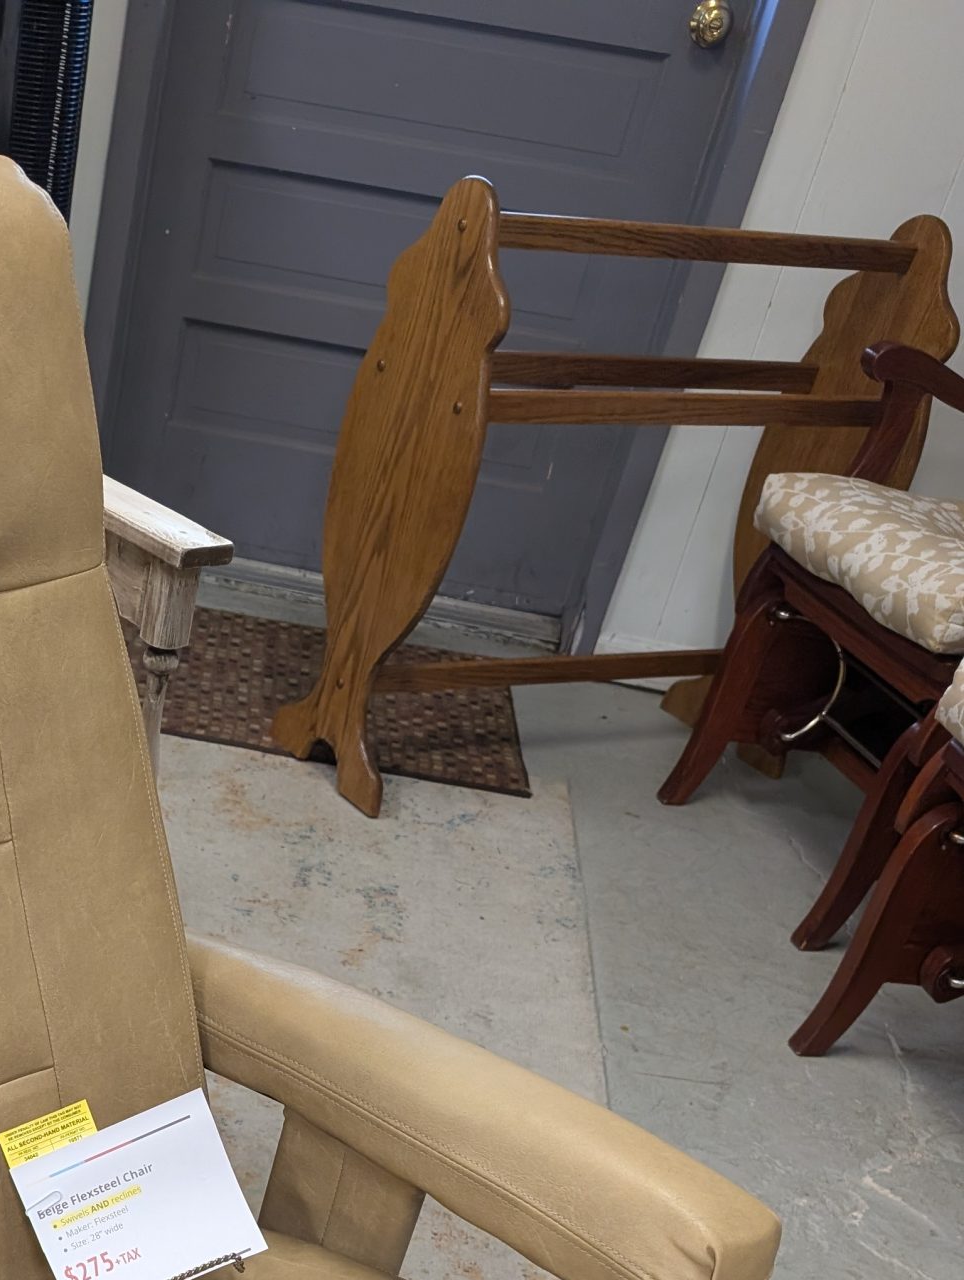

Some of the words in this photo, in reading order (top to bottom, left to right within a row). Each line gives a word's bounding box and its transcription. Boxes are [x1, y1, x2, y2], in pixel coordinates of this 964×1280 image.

[6, 1145, 18, 1153] ALL
[18, 1128, 61, 1148] SECOND-HAND
[60, 1116, 90, 1131] MATERIAL
[37, 1201, 69, 1220] Beige
[70, 1177, 121, 1206] Flexsteel
[123, 1163, 153, 1183] Chair
[60, 1208, 90, 1227] Swivels
[90, 1199, 110, 1214] AND
[111, 1185, 142, 1205] reclines
[65, 1221, 94, 1239] Maker:
[94, 1205, 129, 1227] Flexsteel
[104, 1221, 124, 1236] wide
